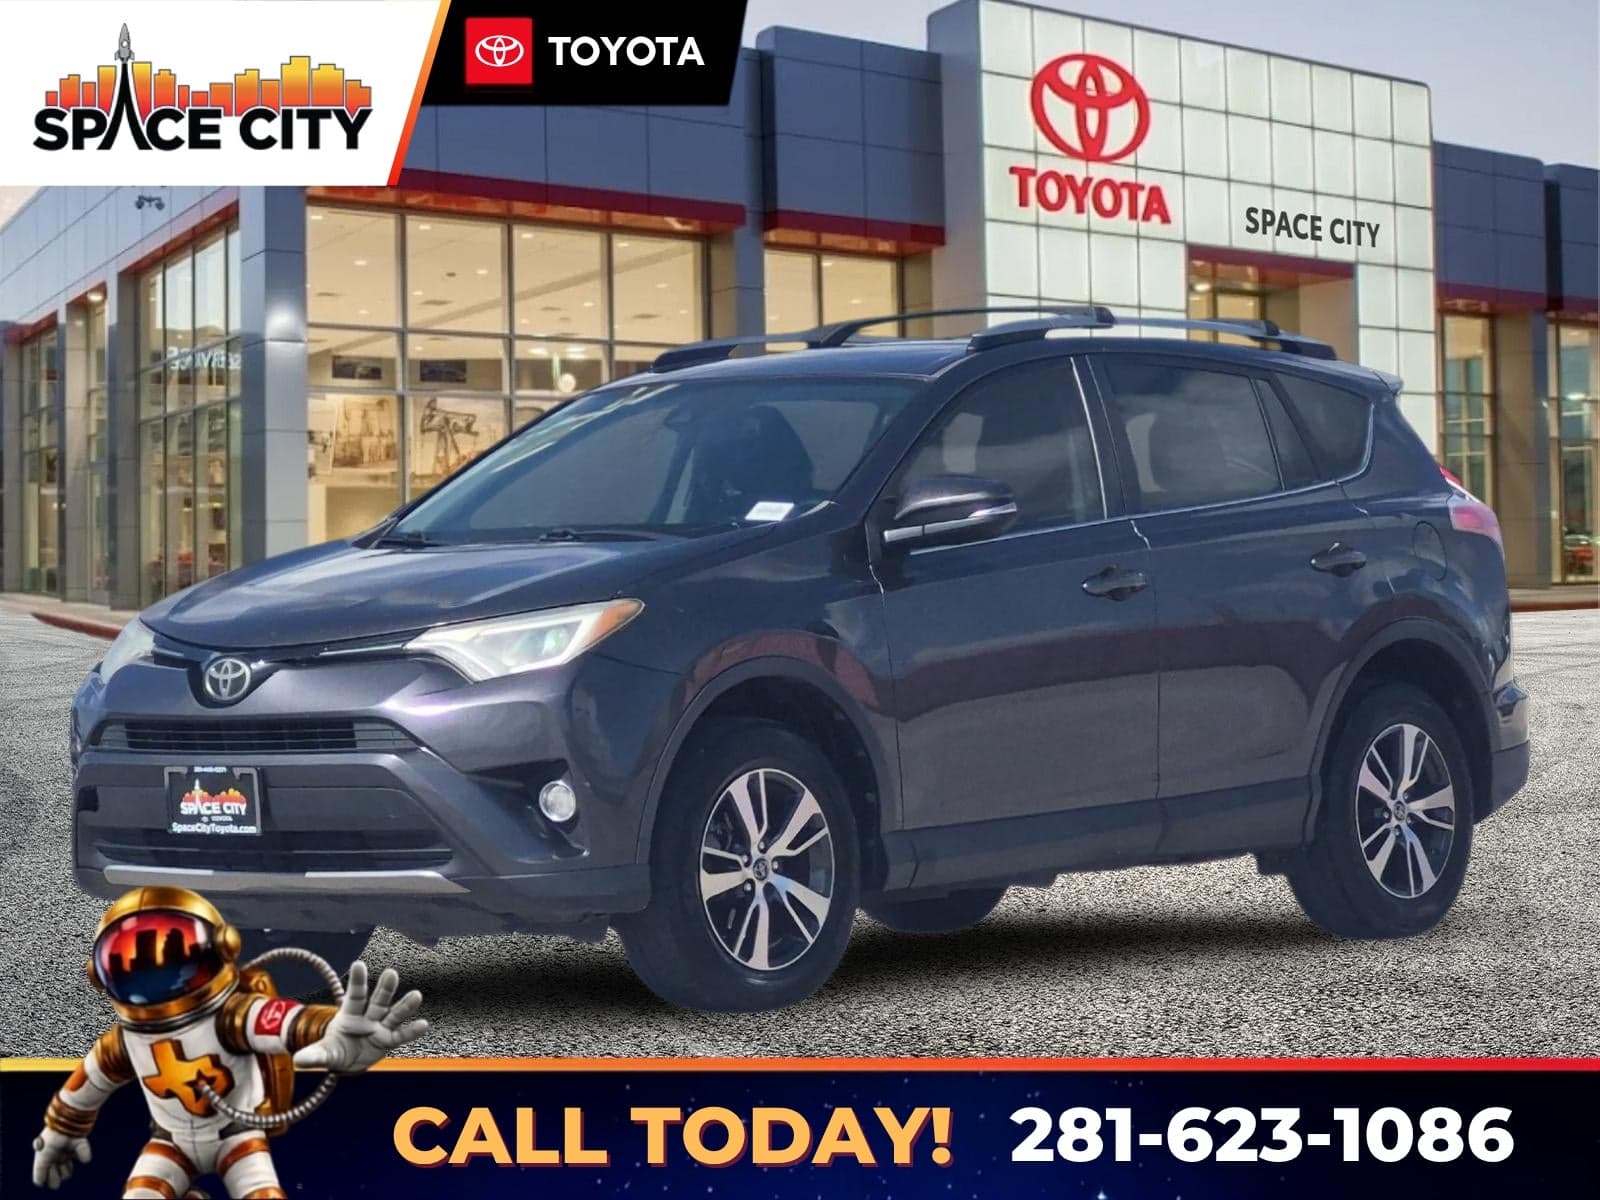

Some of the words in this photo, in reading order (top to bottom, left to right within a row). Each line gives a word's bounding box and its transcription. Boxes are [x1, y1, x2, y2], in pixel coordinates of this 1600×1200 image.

[1008, 165, 1172, 225] TOYOTA
[1245, 206, 1323, 242] SPACE
[1329, 217, 1381, 248] CITY
[180, 801, 222, 815] SPACE
[222, 801, 247, 816] CITY
[172, 821, 258, 835] SpaceCityToyota.com
